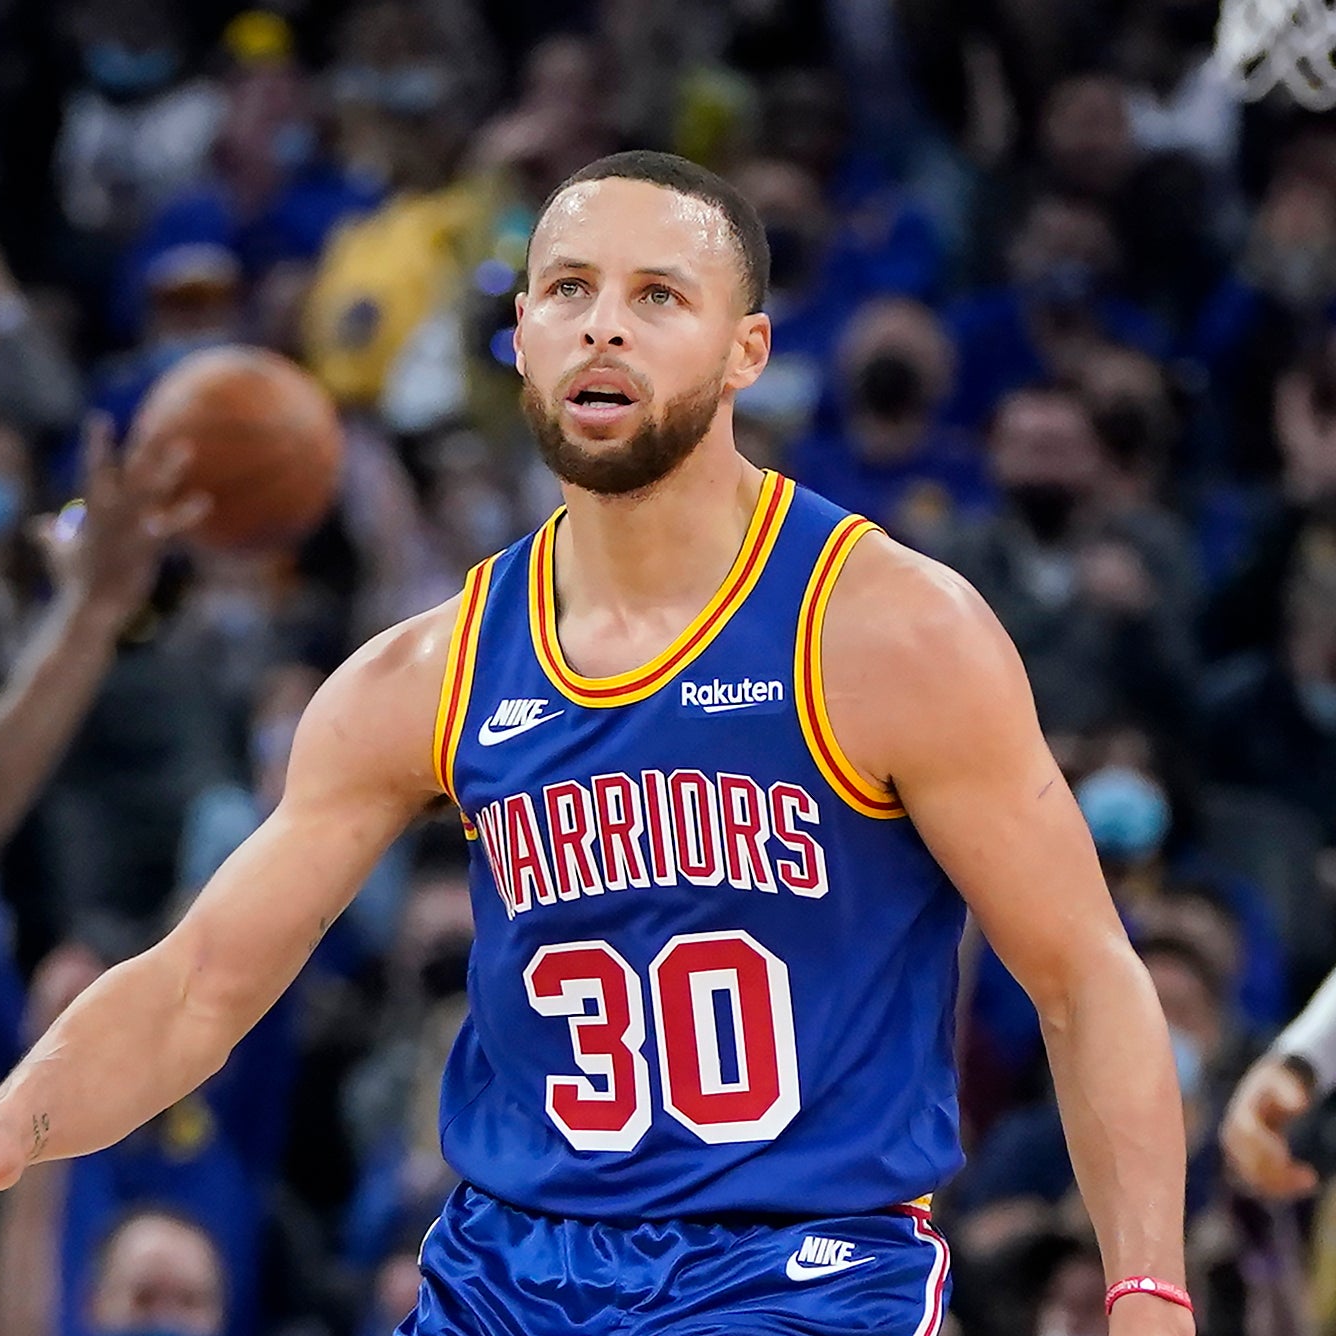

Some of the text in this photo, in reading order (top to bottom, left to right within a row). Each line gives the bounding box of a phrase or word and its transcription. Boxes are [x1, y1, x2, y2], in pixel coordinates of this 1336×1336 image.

[680, 677, 784, 706] Rakuten
[490, 699, 549, 728] NIKE
[476, 768, 830, 921] WARRIORS
[522, 929, 801, 1152] 30
[797, 1235, 856, 1266] NIKE
